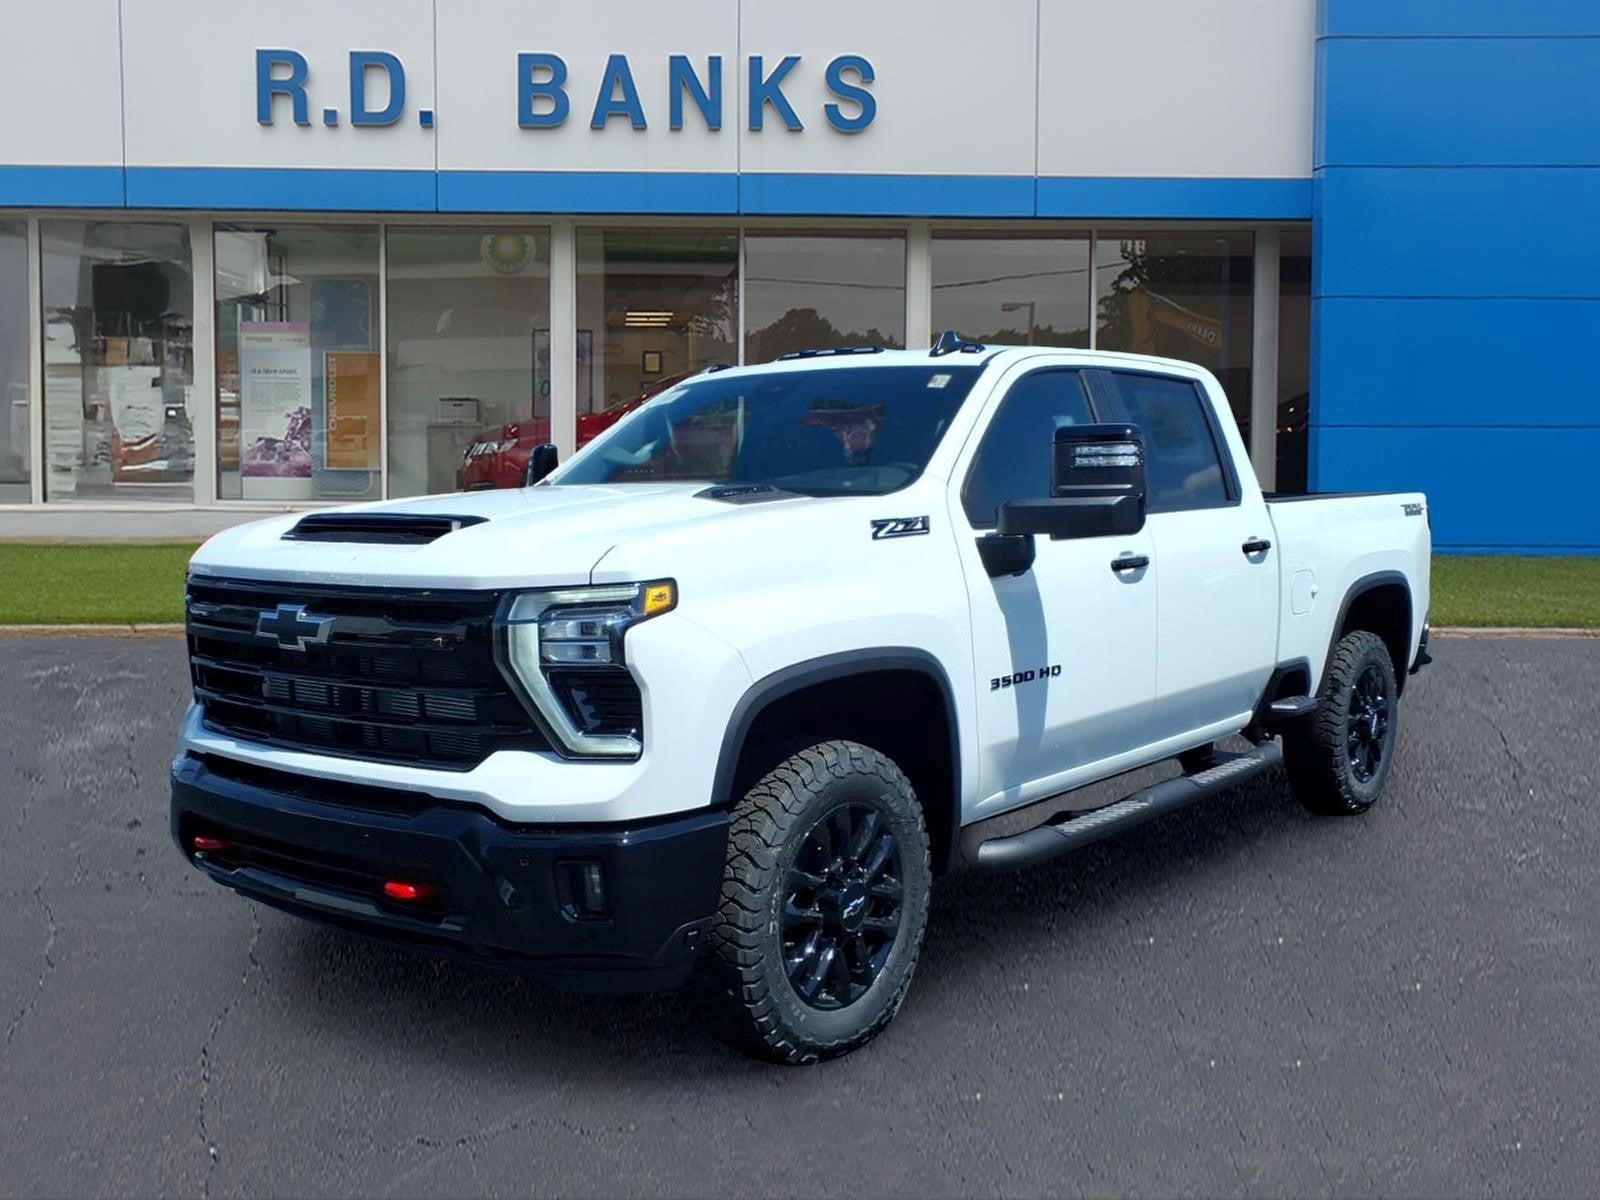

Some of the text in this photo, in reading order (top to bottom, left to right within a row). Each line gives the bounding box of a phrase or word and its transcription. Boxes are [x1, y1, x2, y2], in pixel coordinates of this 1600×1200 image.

[255, 48, 877, 133] R.D. BANKS
[870, 515, 930, 540] Z71
[990, 664, 1062, 692] 3500 HD
